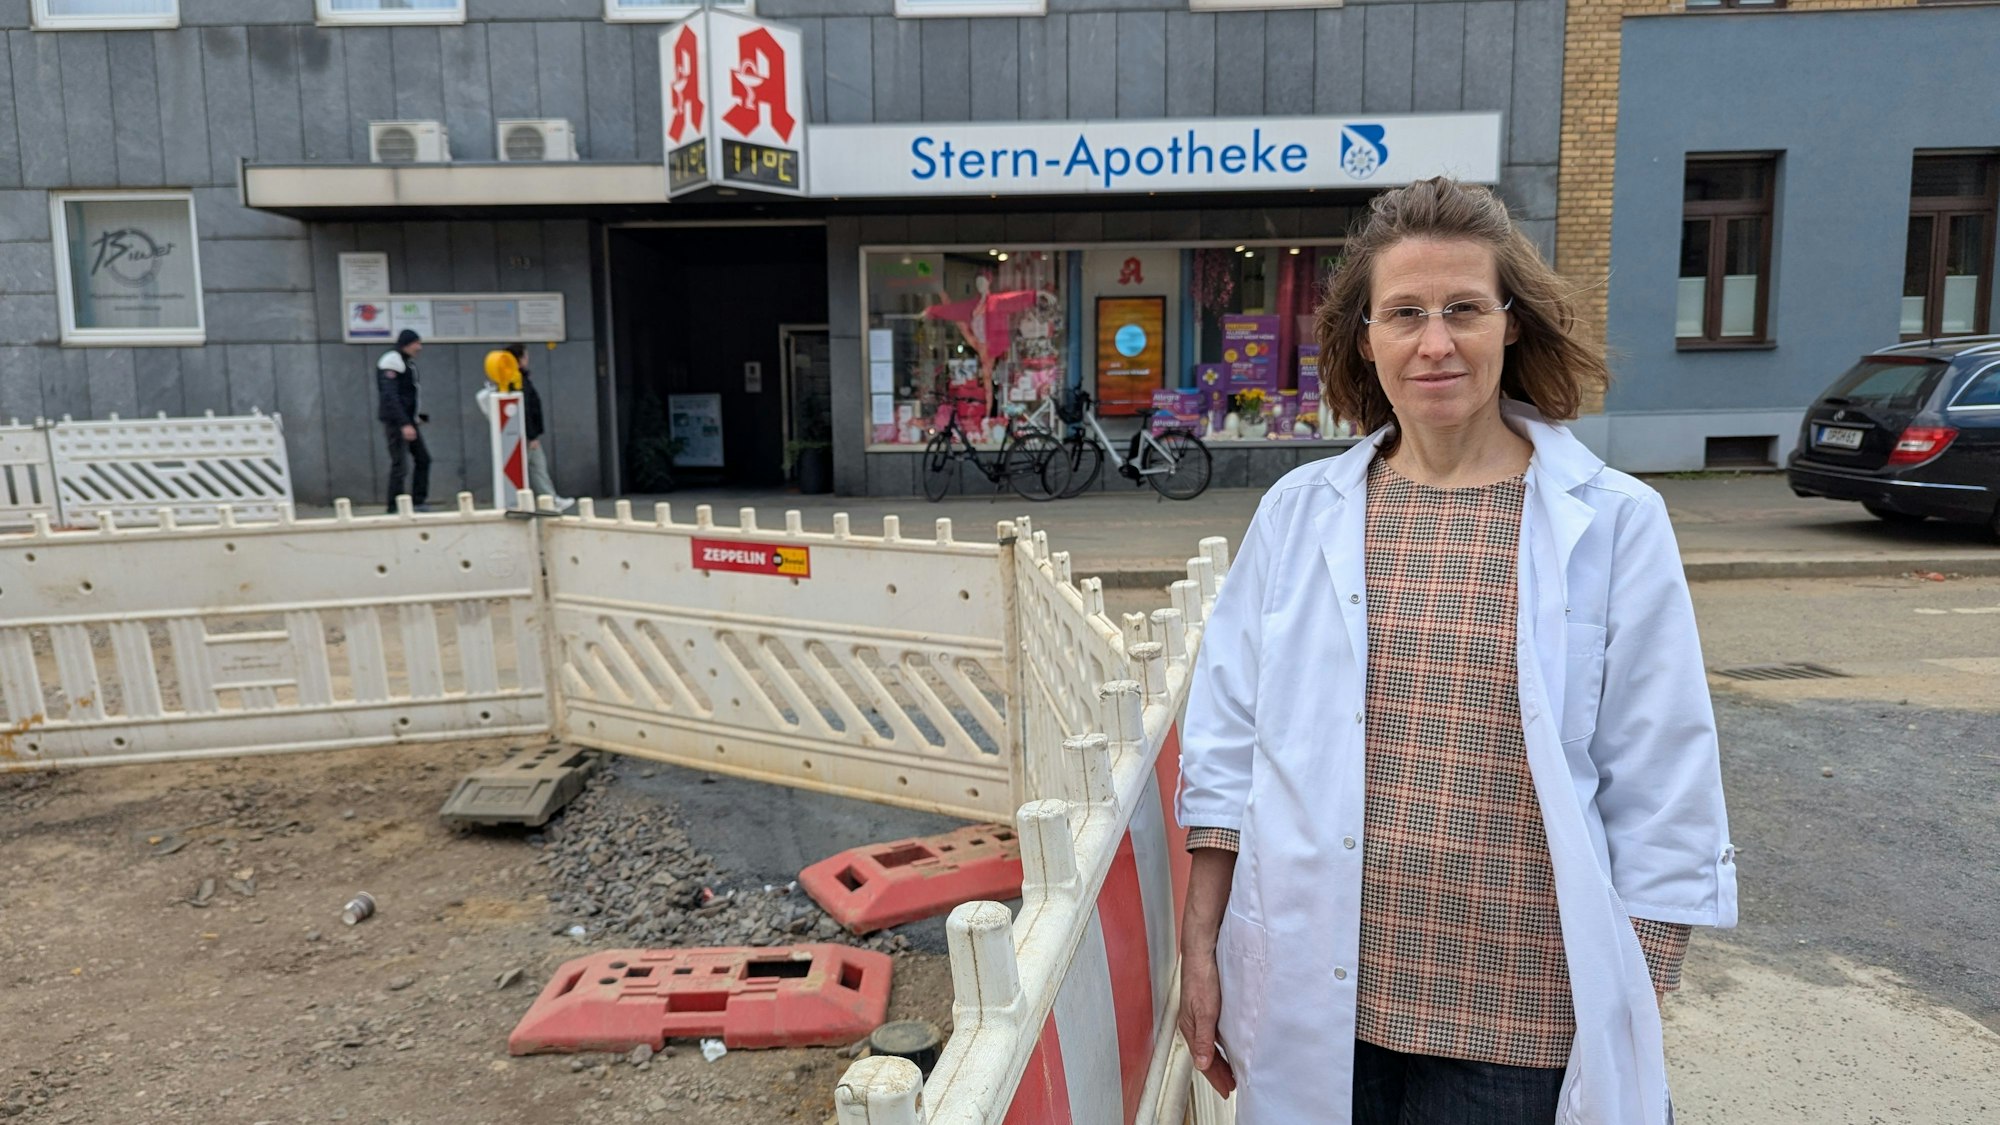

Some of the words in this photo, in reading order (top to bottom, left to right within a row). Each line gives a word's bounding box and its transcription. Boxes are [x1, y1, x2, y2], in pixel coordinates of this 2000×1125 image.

[911, 128, 1308, 188] Stern-Apotheke
[1153, 394, 1180, 402] Allegra
[703, 548, 766, 565] ZEPPELIN
